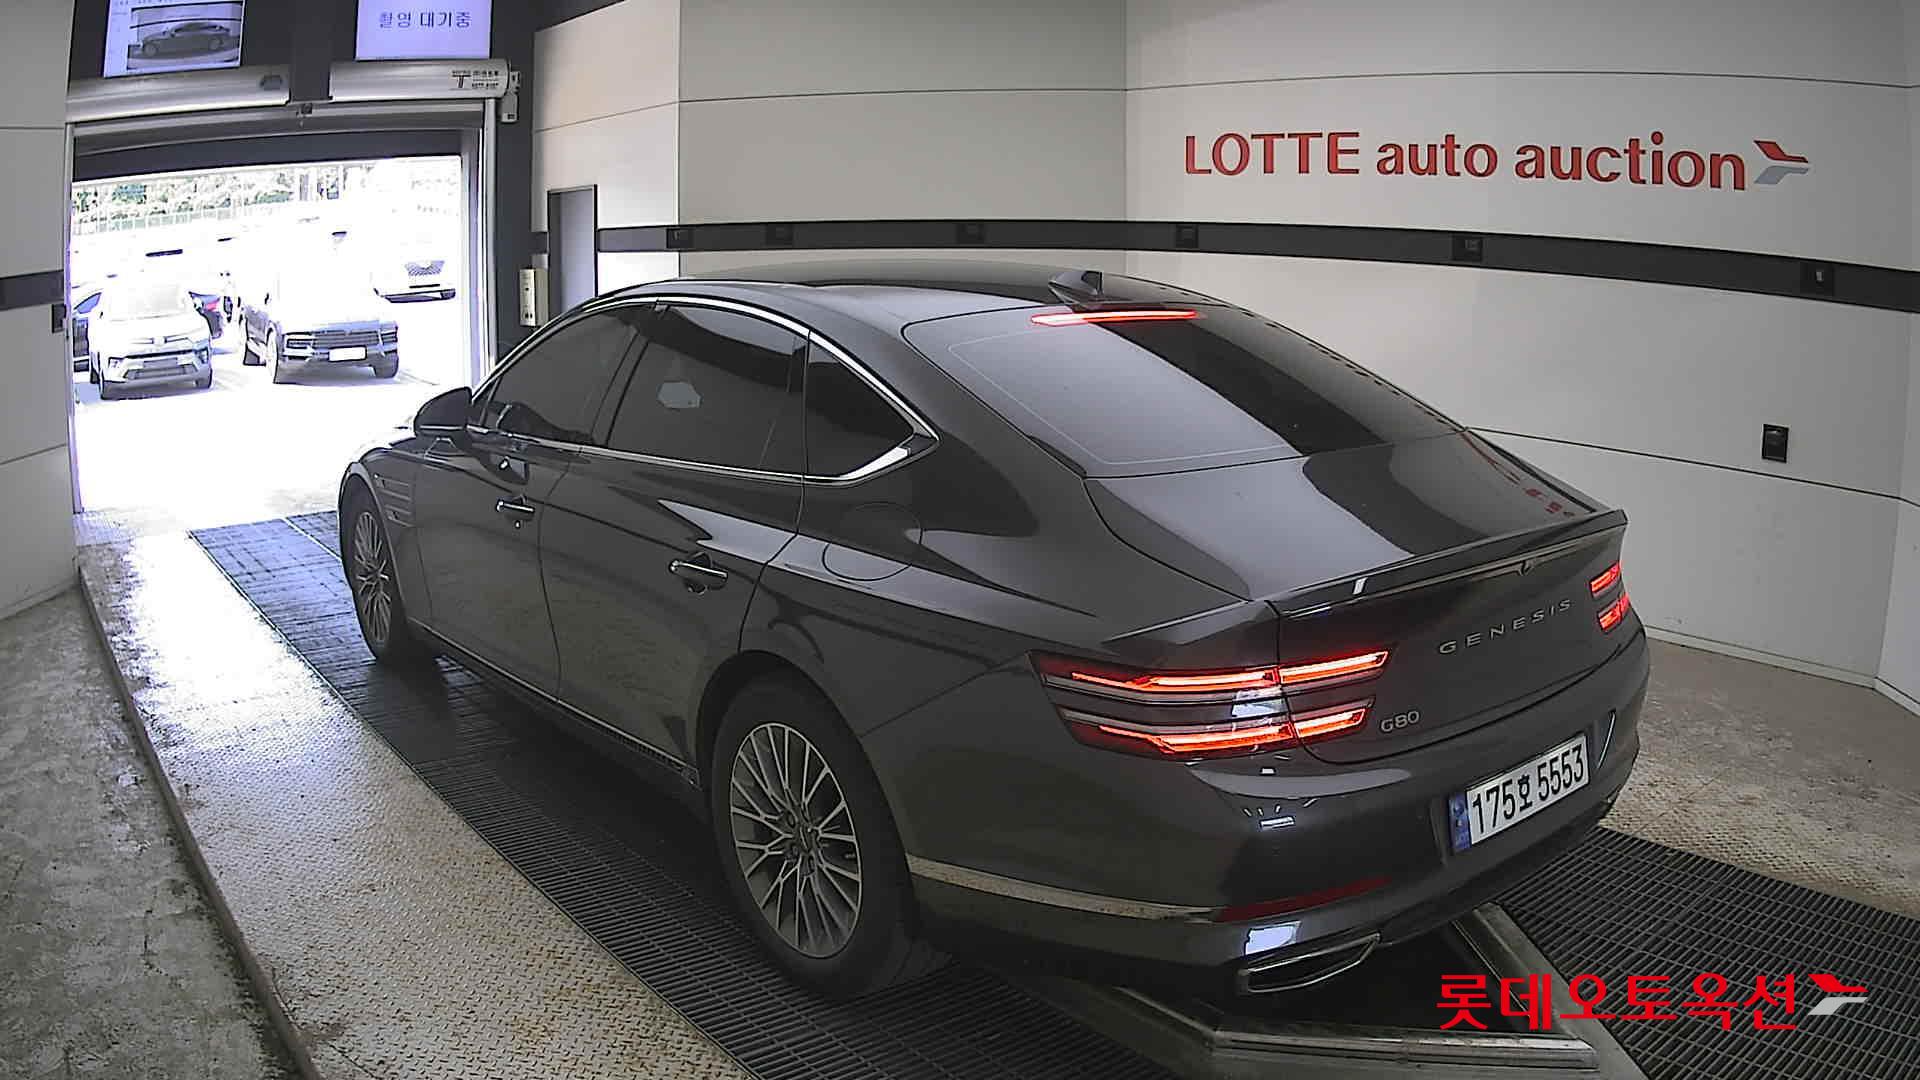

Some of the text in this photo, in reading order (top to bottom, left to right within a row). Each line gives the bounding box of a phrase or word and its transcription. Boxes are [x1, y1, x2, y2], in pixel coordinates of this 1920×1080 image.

[420, 11, 472, 29] 대기중
[1185, 131, 1746, 190] LOTTE auto auction
[1439, 598, 1571, 654] GENESIS
[1380, 710, 1420, 733] G80
[1537, 743, 1584, 801] 5553
